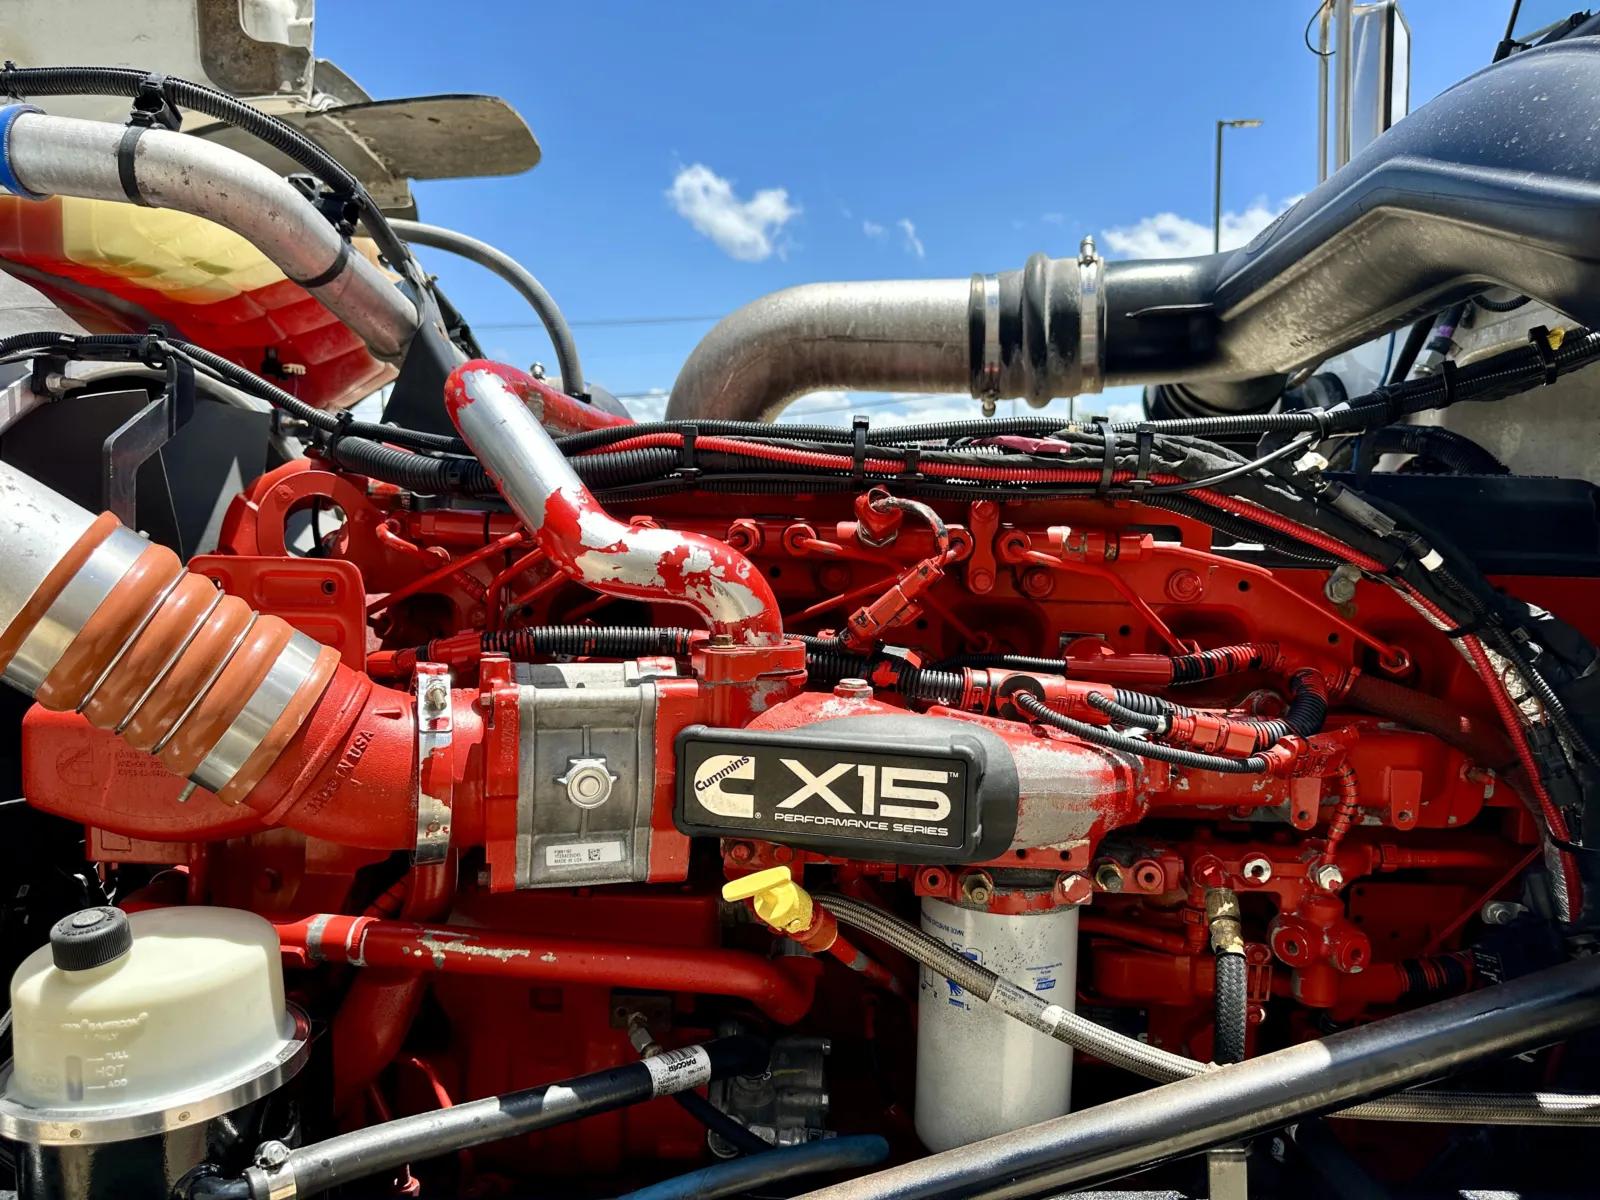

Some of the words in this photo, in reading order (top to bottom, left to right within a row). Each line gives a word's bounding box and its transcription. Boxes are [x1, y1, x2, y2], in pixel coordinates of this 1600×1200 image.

[346, 729, 375, 758] USA
[695, 755, 750, 792] Cummins
[774, 812, 888, 831] PERFORMANCE
[892, 823, 949, 836] SERIES
[96, 1064, 124, 1078] HOT
[667, 1057, 697, 1072] PACCAR
